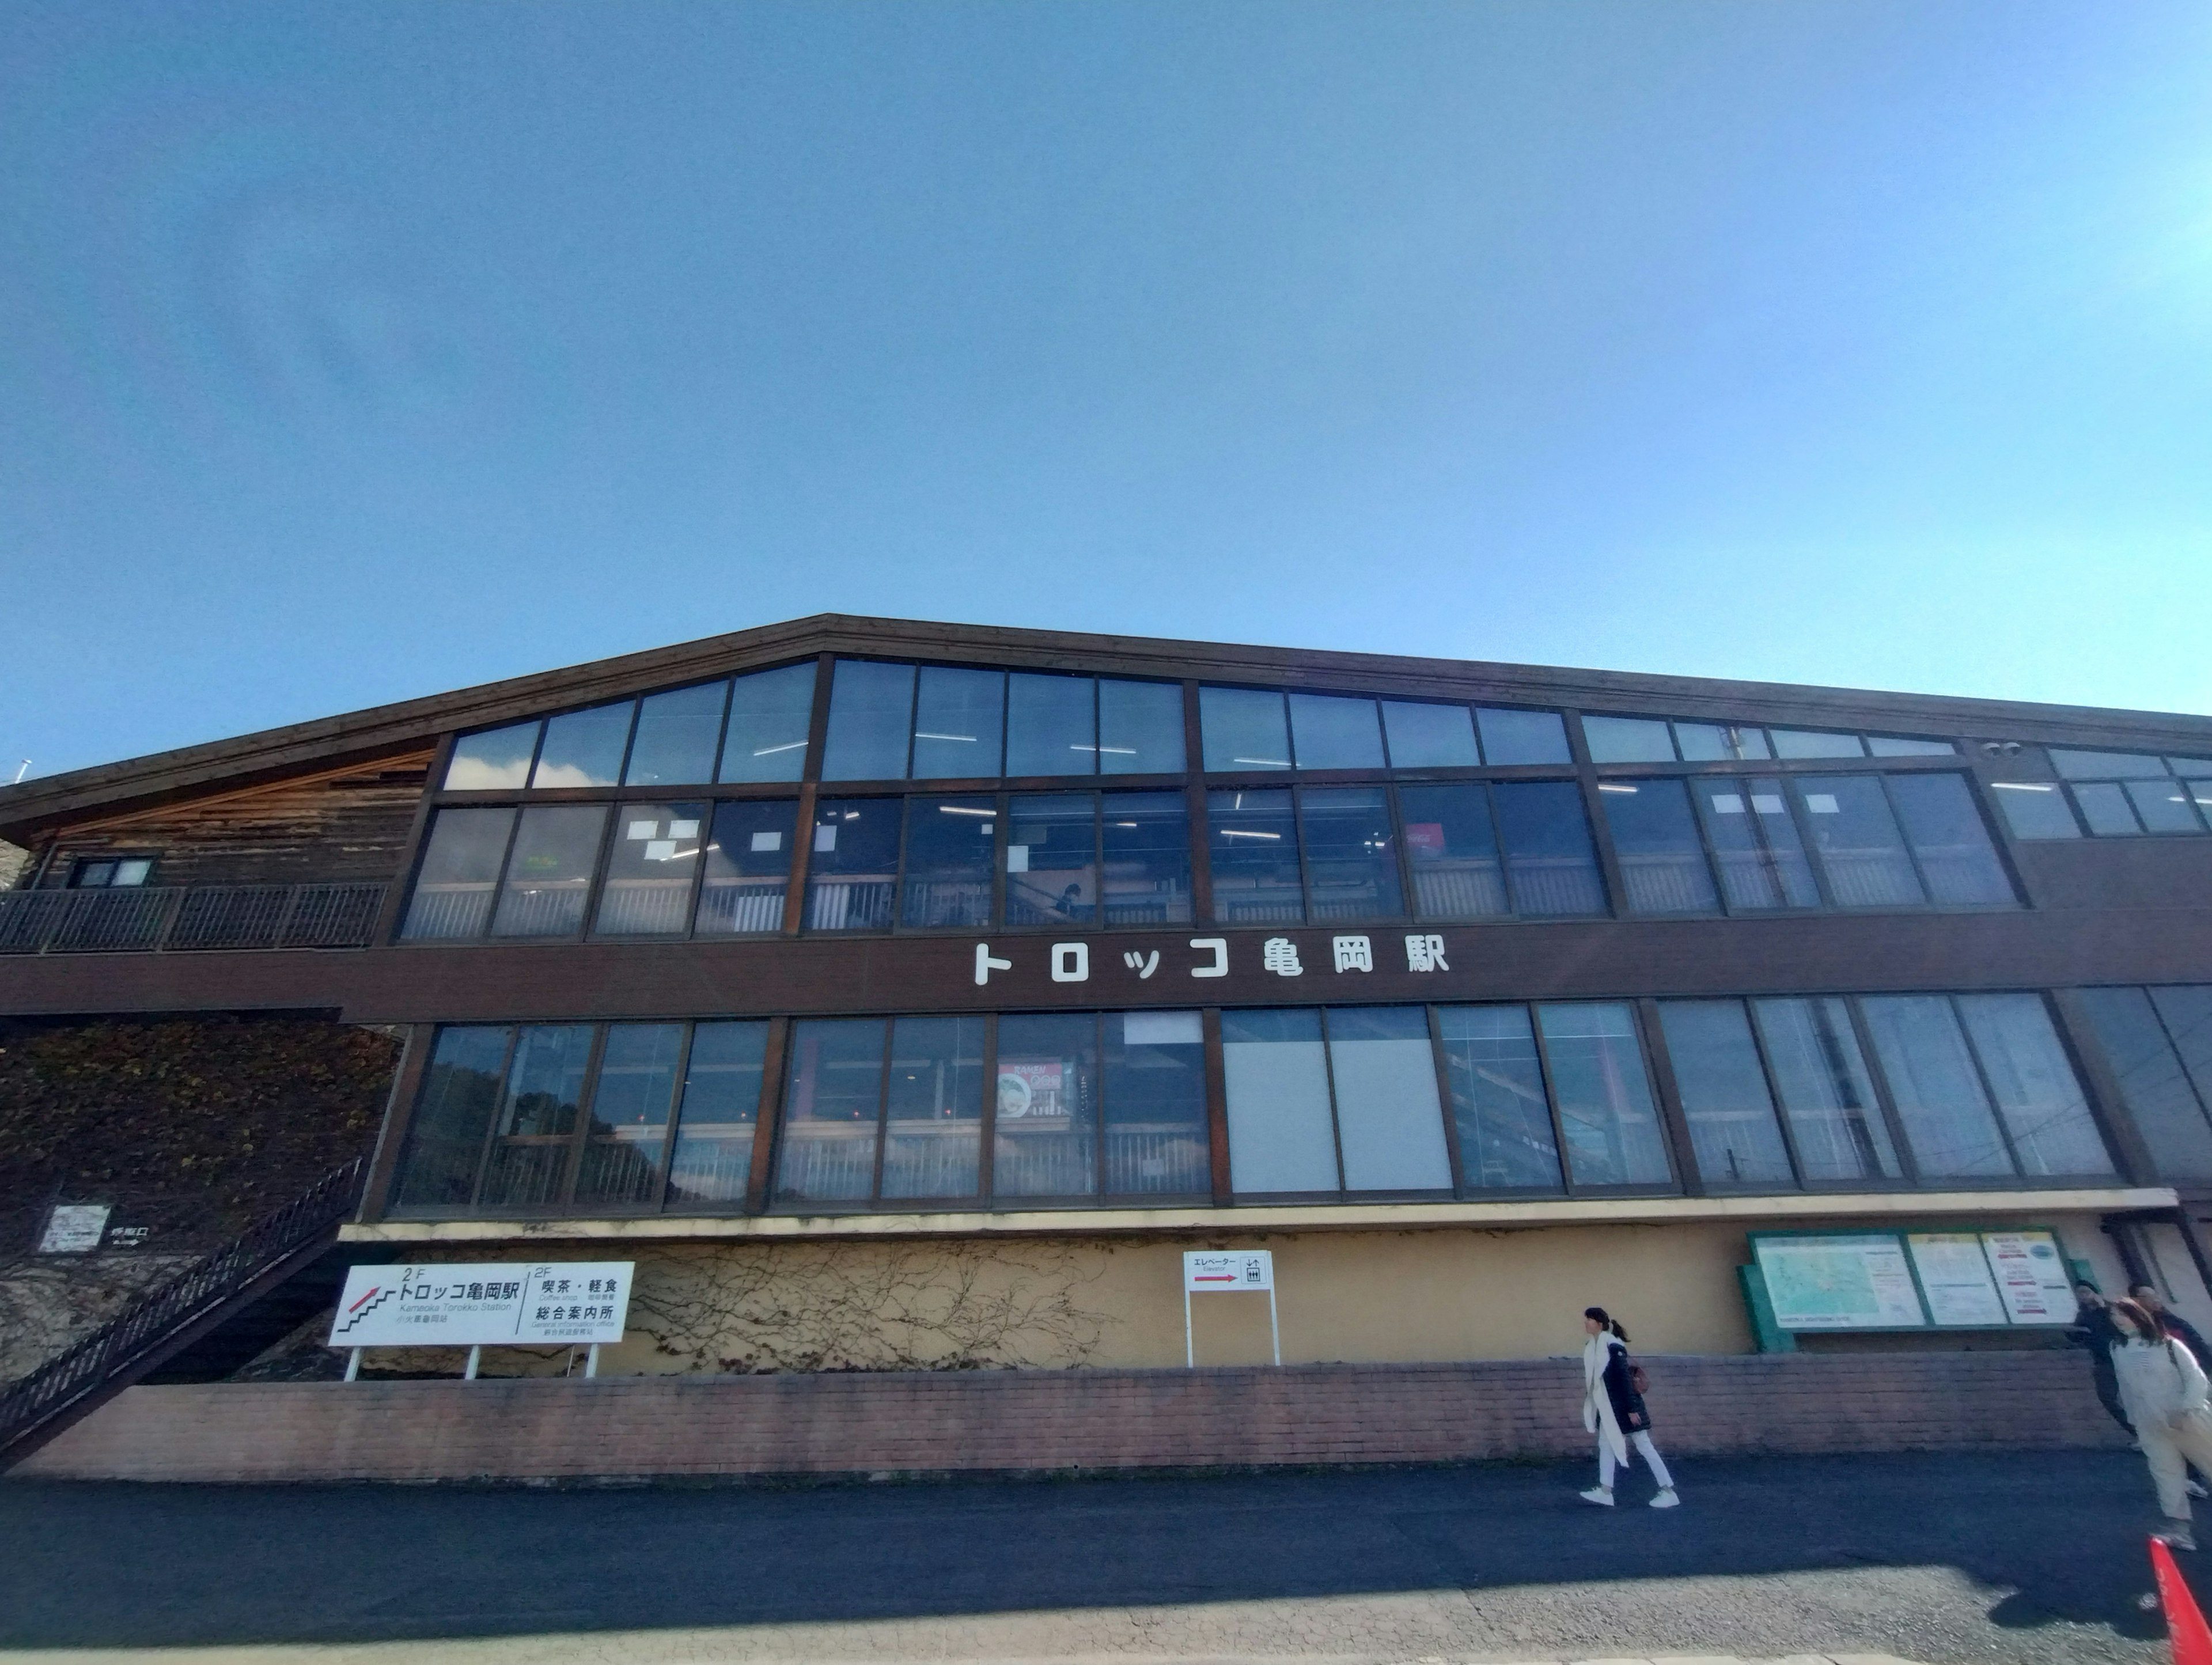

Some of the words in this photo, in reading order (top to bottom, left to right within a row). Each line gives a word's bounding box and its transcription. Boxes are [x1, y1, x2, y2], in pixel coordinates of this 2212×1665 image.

[975, 934, 1449, 985] トロッコ亀岡駅
[1014, 1065, 1046, 1075] RAMEN
[1194, 1258, 1236, 1266] エレベーター
[534, 1267, 552, 1278] 2F
[400, 1282, 520, 1300] トロッコ亀岡駅
[541, 1279, 618, 1294] 喫茶・軽食
[443, 1303, 478, 1311] Torokko
[480, 1302, 512, 1311] Station
[535, 1305, 614, 1320] 総合案内所
